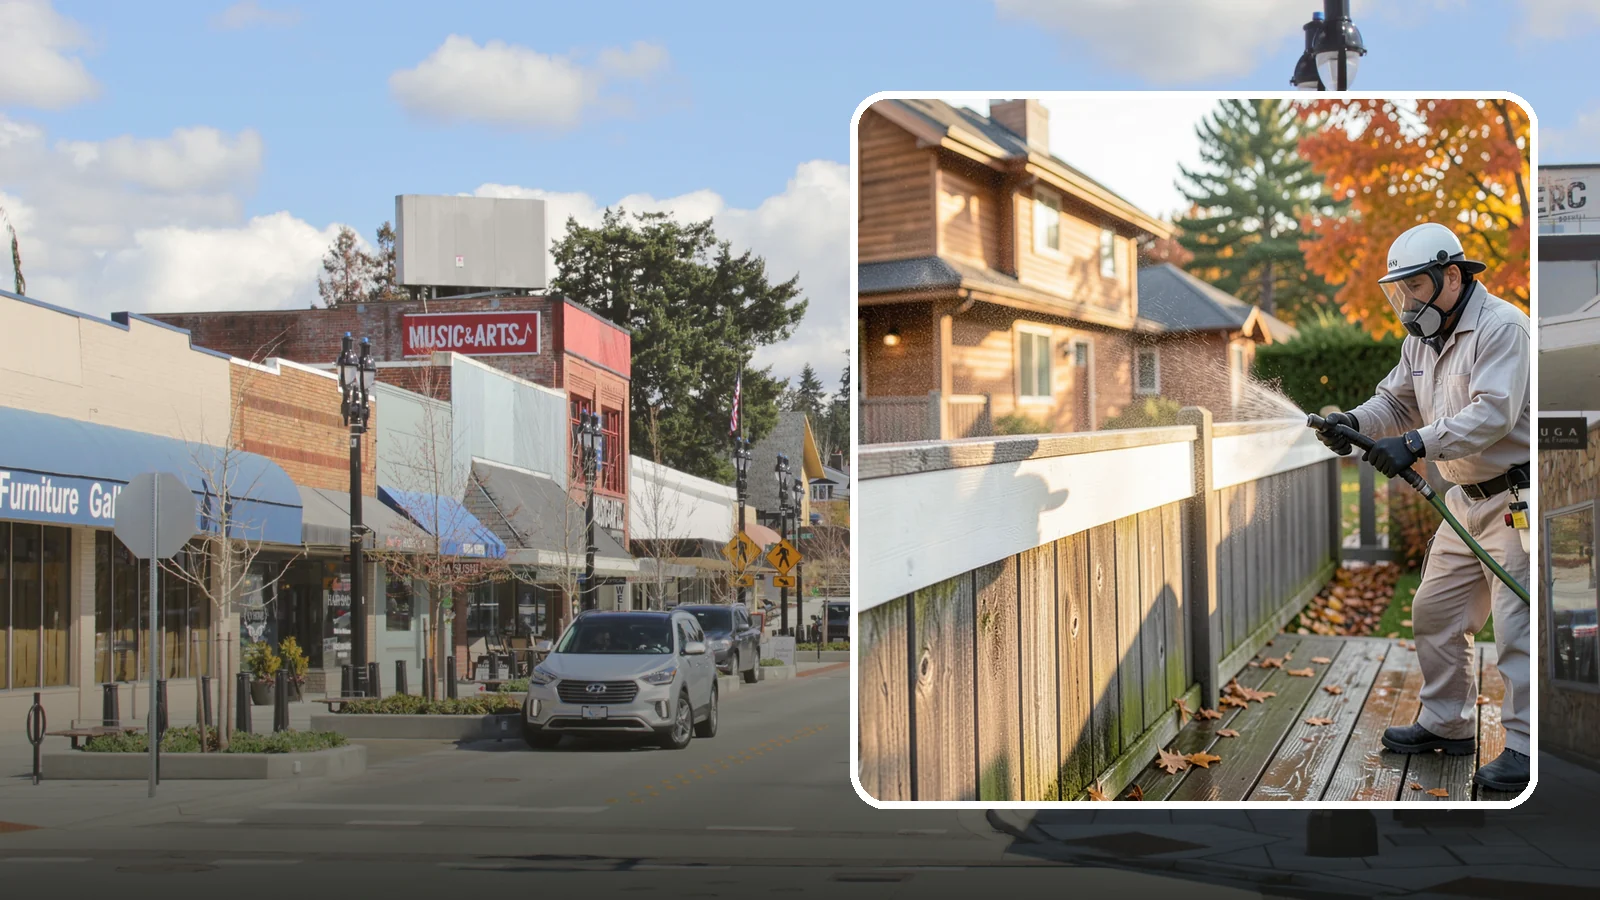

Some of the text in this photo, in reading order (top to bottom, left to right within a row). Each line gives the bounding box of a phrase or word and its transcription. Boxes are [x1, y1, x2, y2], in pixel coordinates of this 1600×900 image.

[0, 471, 122, 520] Furniture Gal
[453, 563, 479, 575] SUSHI
